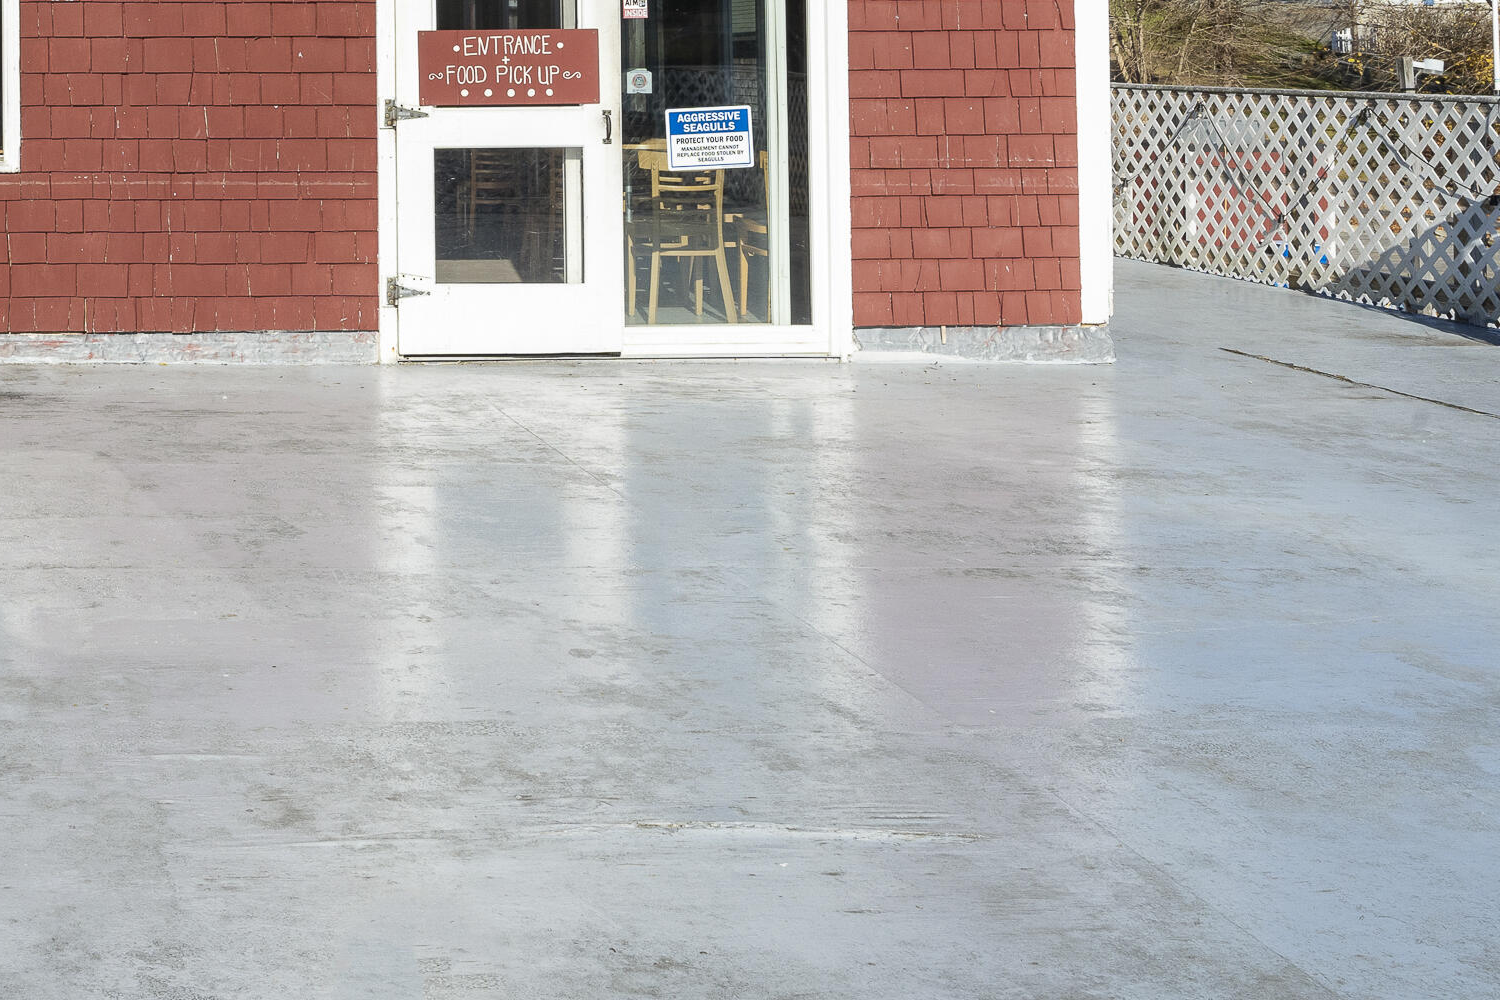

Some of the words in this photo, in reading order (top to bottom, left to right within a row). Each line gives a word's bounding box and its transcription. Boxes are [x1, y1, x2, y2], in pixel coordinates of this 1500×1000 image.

[624, 9, 647, 17] INSIDE
[463, 34, 552, 57] ENTRANCE
[446, 65, 487, 85] FOOD
[496, 65, 532, 85] PICK
[537, 65, 560, 85] UP
[677, 111, 741, 123] AGGRESSIVE
[683, 121, 736, 133] SEAGULLS
[676, 136, 704, 145] PROTECT
[705, 135, 724, 143] YOUR
